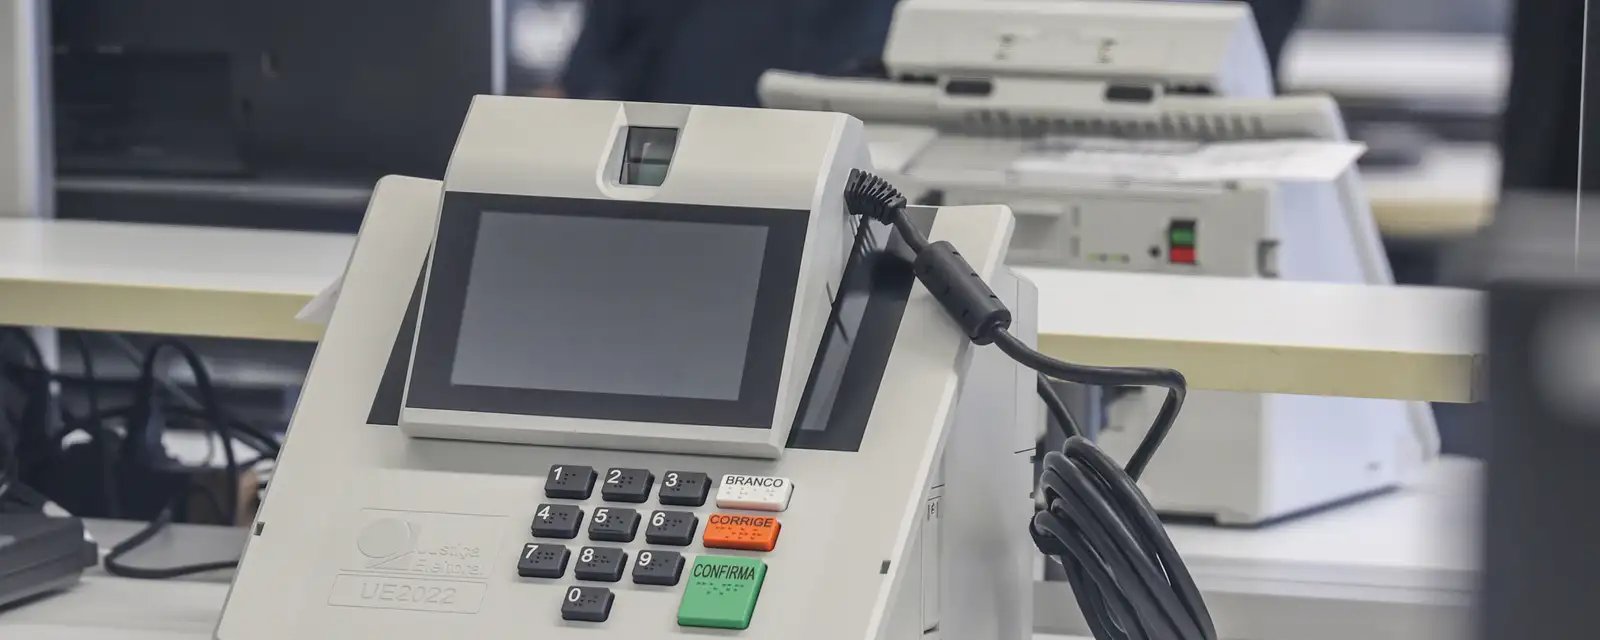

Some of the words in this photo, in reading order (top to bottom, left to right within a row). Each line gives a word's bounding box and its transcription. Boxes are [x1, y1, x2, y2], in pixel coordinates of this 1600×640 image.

[554, 466, 563, 480] 1
[607, 469, 621, 484] 2
[665, 472, 678, 487] 3
[725, 475, 784, 488] BRANCO
[537, 505, 549, 520] 4
[594, 508, 608, 523] 5
[652, 512, 665, 527] 6
[709, 514, 773, 528] CORRIGE
[526, 544, 538, 558] 7
[581, 548, 594, 562] 8
[639, 551, 652, 566] 9
[693, 563, 756, 581] CONFIRMA
[360, 582, 457, 605] UE2022
[568, 587, 581, 602] 0
